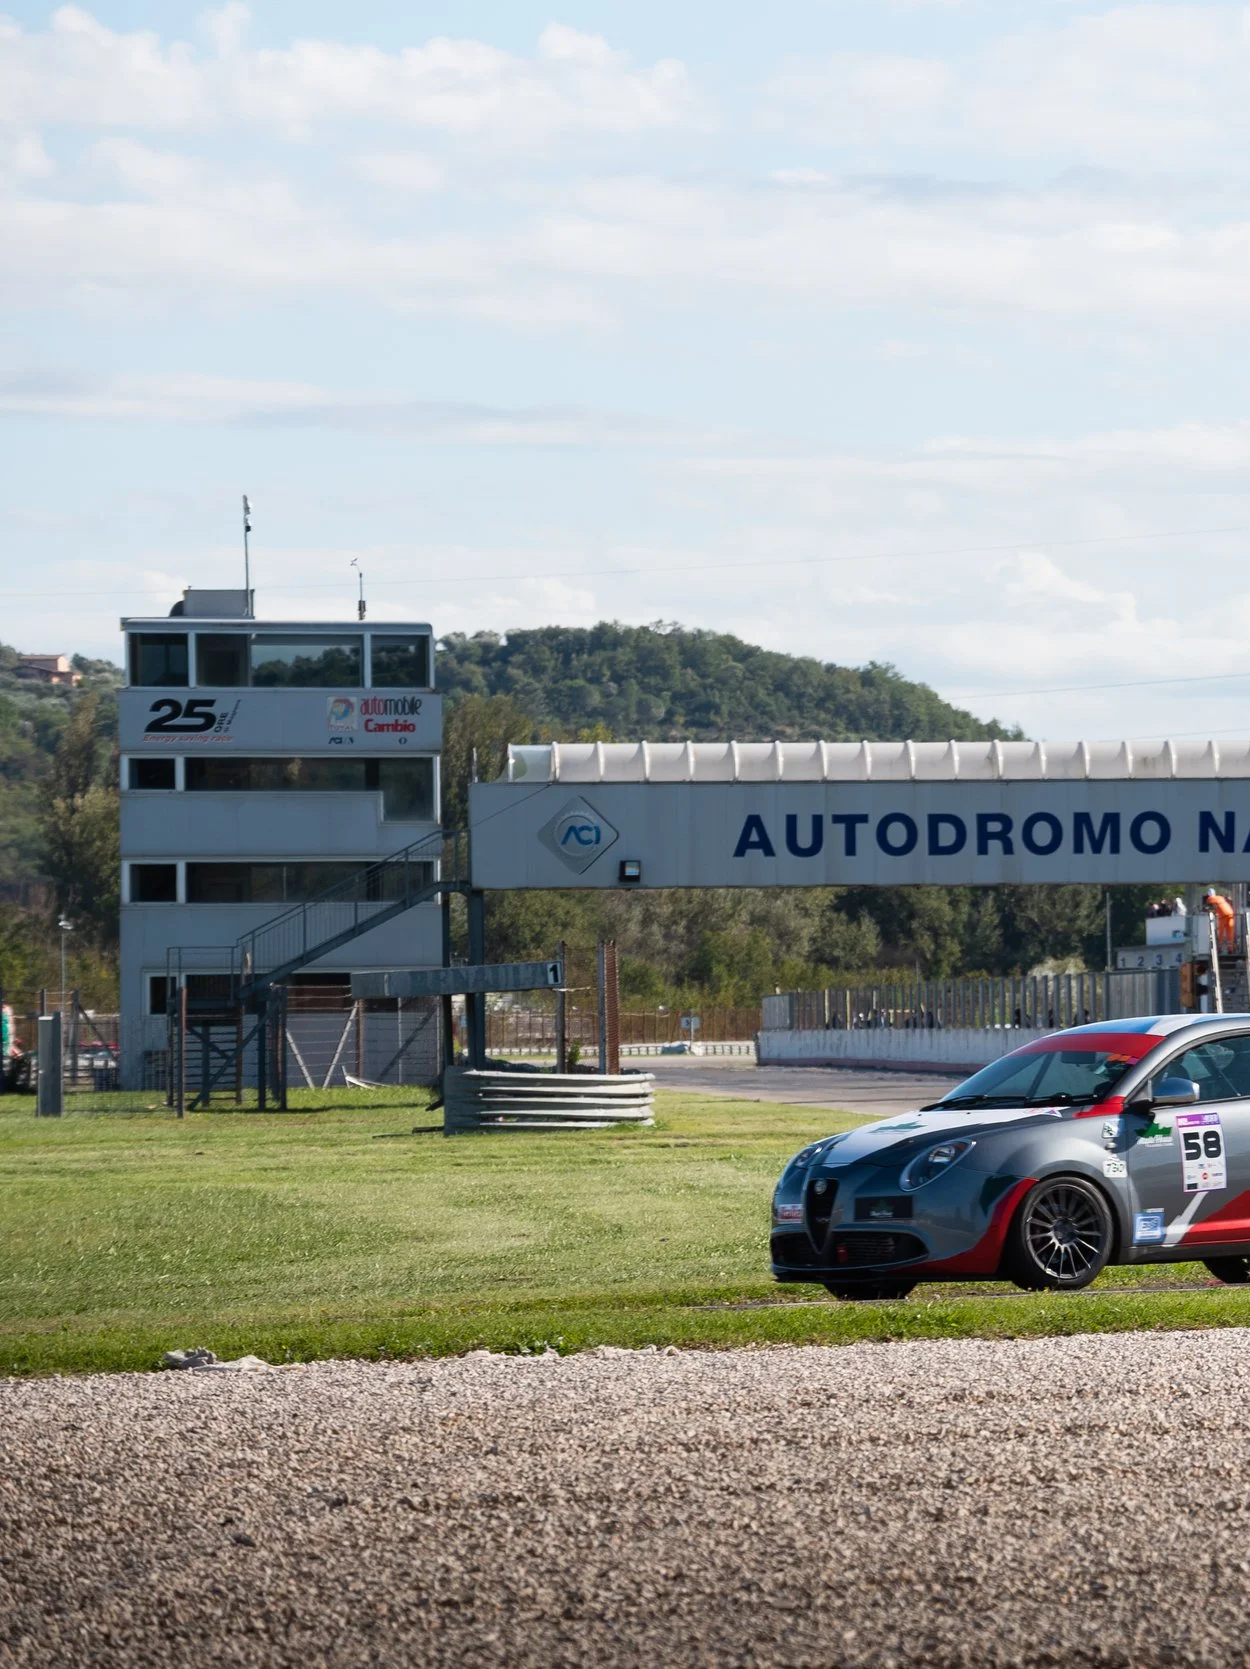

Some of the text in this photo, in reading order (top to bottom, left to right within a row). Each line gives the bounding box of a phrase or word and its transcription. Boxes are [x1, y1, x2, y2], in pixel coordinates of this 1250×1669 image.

[144, 698, 217, 733] 25
[360, 696, 422, 716] automobile
[364, 718, 417, 733] Cambio
[560, 825, 602, 846] ACI
[733, 811, 1171, 858] AUTODROMO
[1120, 957, 1126, 967] 1
[1137, 956, 1145, 967] 2
[1155, 954, 1163, 966] 3
[1175, 953, 1183, 963] 4
[548, 963, 560, 984] 1
[1182, 1130, 1222, 1161] 58
